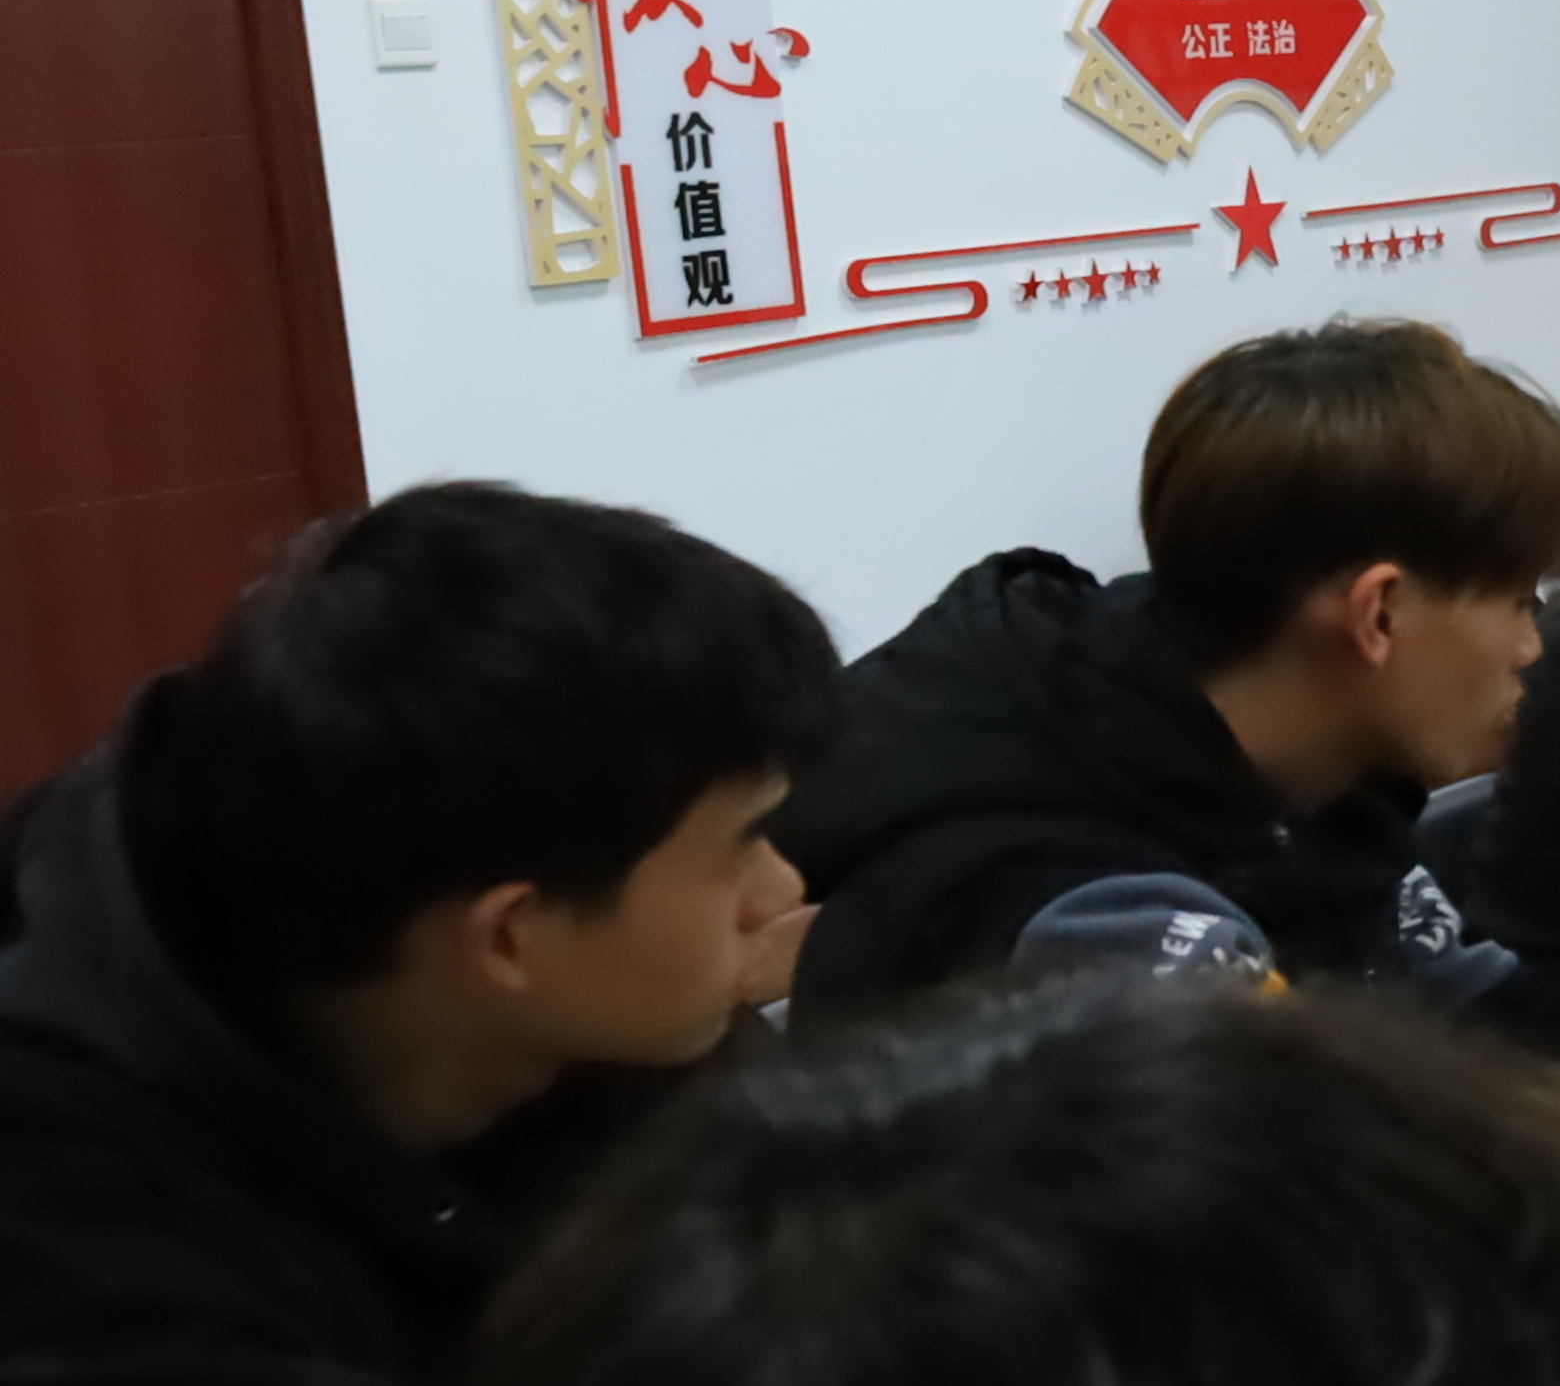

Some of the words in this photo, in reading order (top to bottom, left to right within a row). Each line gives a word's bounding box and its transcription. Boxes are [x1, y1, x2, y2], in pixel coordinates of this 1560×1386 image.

[1180, 23, 1234, 59] 公正
[1247, 20, 1296, 57] 法治
[666, 112, 734, 308] 价值观
